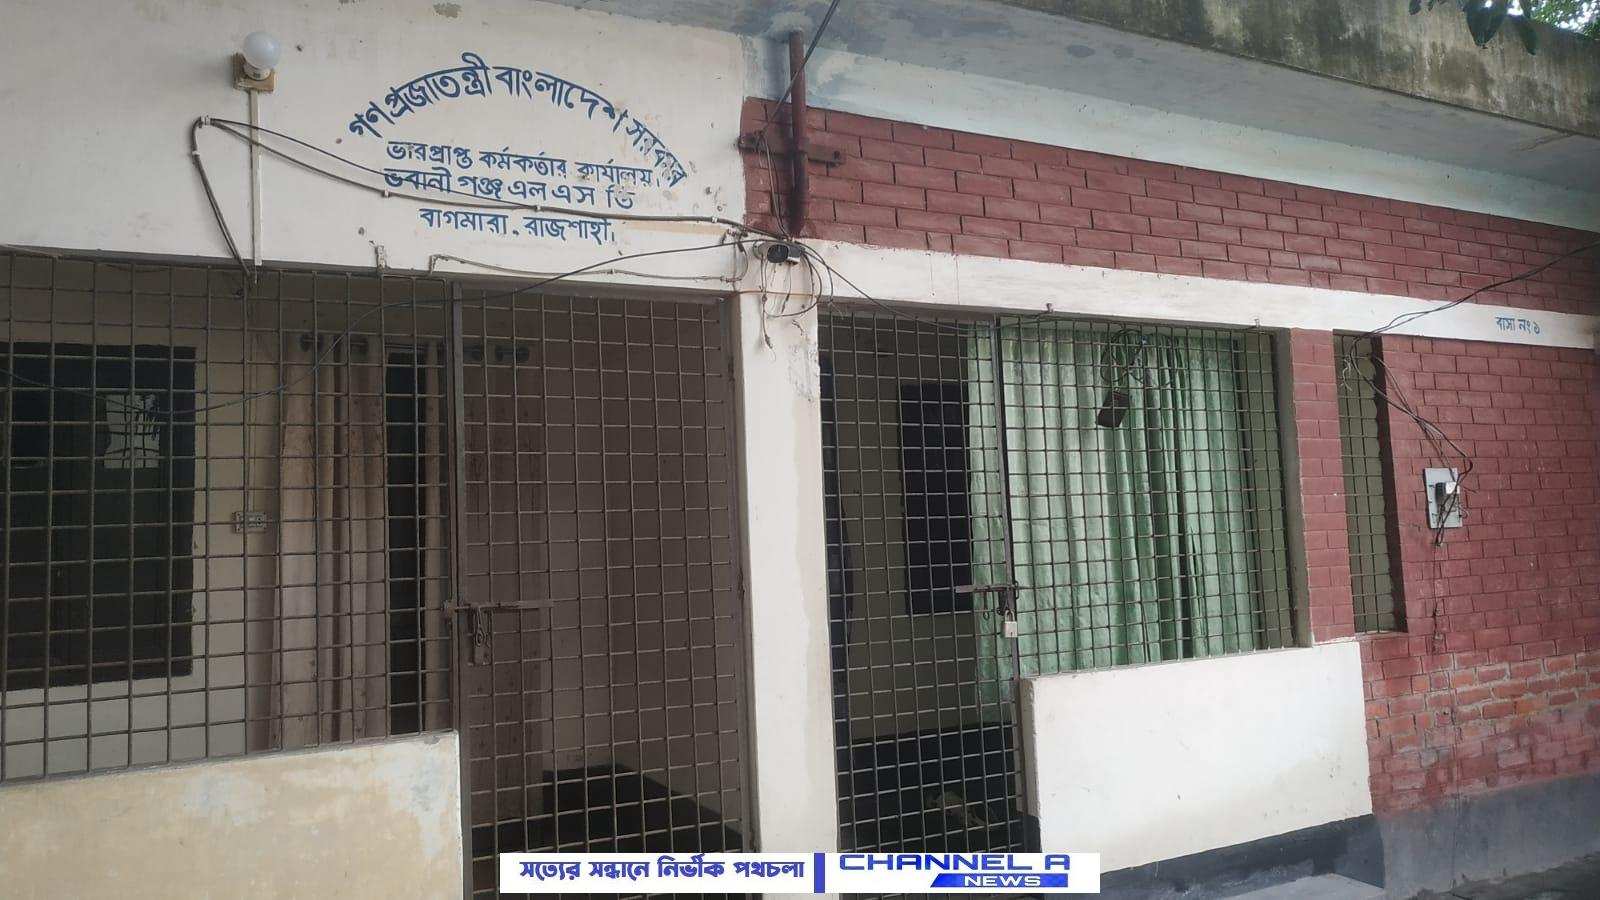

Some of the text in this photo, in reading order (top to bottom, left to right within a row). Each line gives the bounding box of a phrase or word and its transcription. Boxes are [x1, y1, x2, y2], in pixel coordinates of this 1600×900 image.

[493, 66, 628, 132] বাংলাদেশ
[387, 141, 473, 169] ভারপ্রাপ্ত
[479, 147, 567, 178] কর্মকর্তার
[1495, 316, 1515, 331] বাসা
